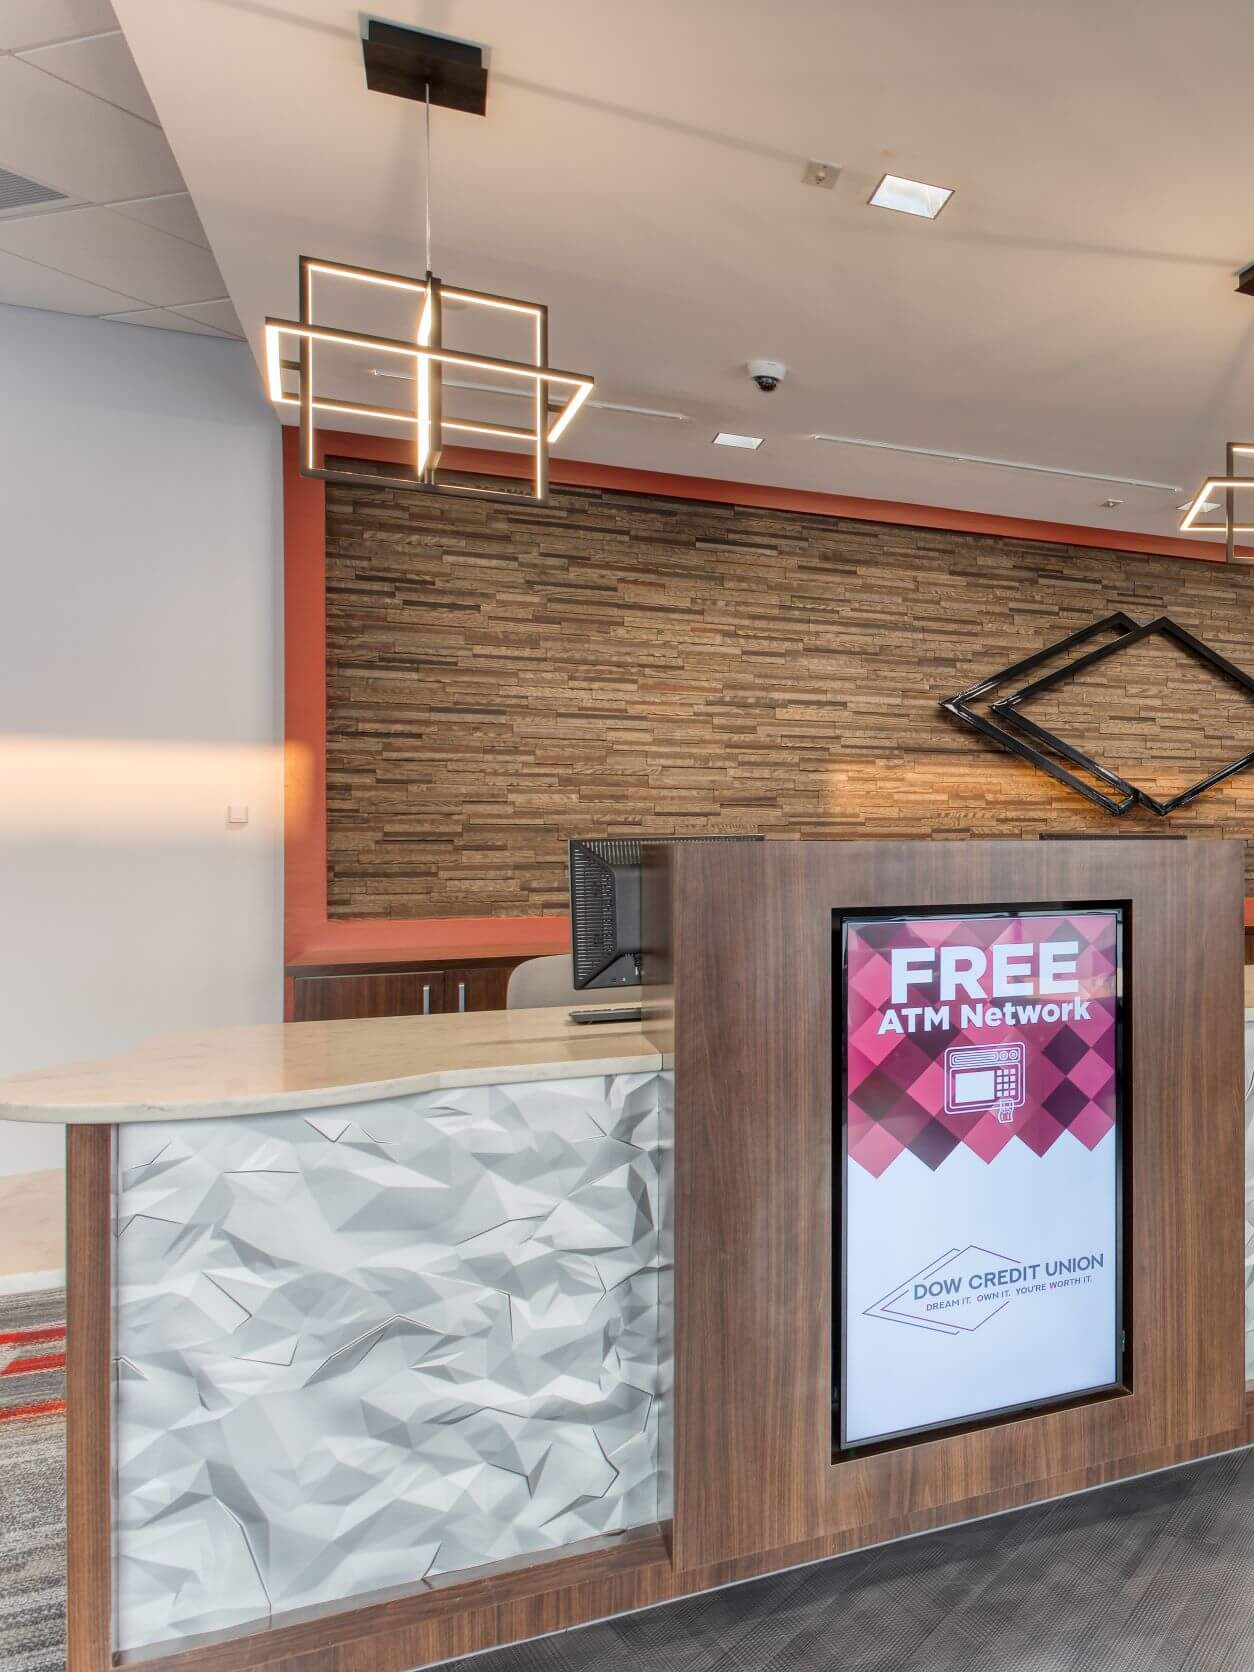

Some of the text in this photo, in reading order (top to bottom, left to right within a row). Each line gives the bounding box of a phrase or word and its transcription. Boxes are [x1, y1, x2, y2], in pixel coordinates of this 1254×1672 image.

[891, 941, 1080, 1004] FREE
[877, 996, 1091, 1035] ATM Network
[913, 1253, 1104, 1300] DOW CREDIT UNION
[925, 1275, 1092, 1312] DREAM IT. OWN IT. YOU'RE WORTH IT.
